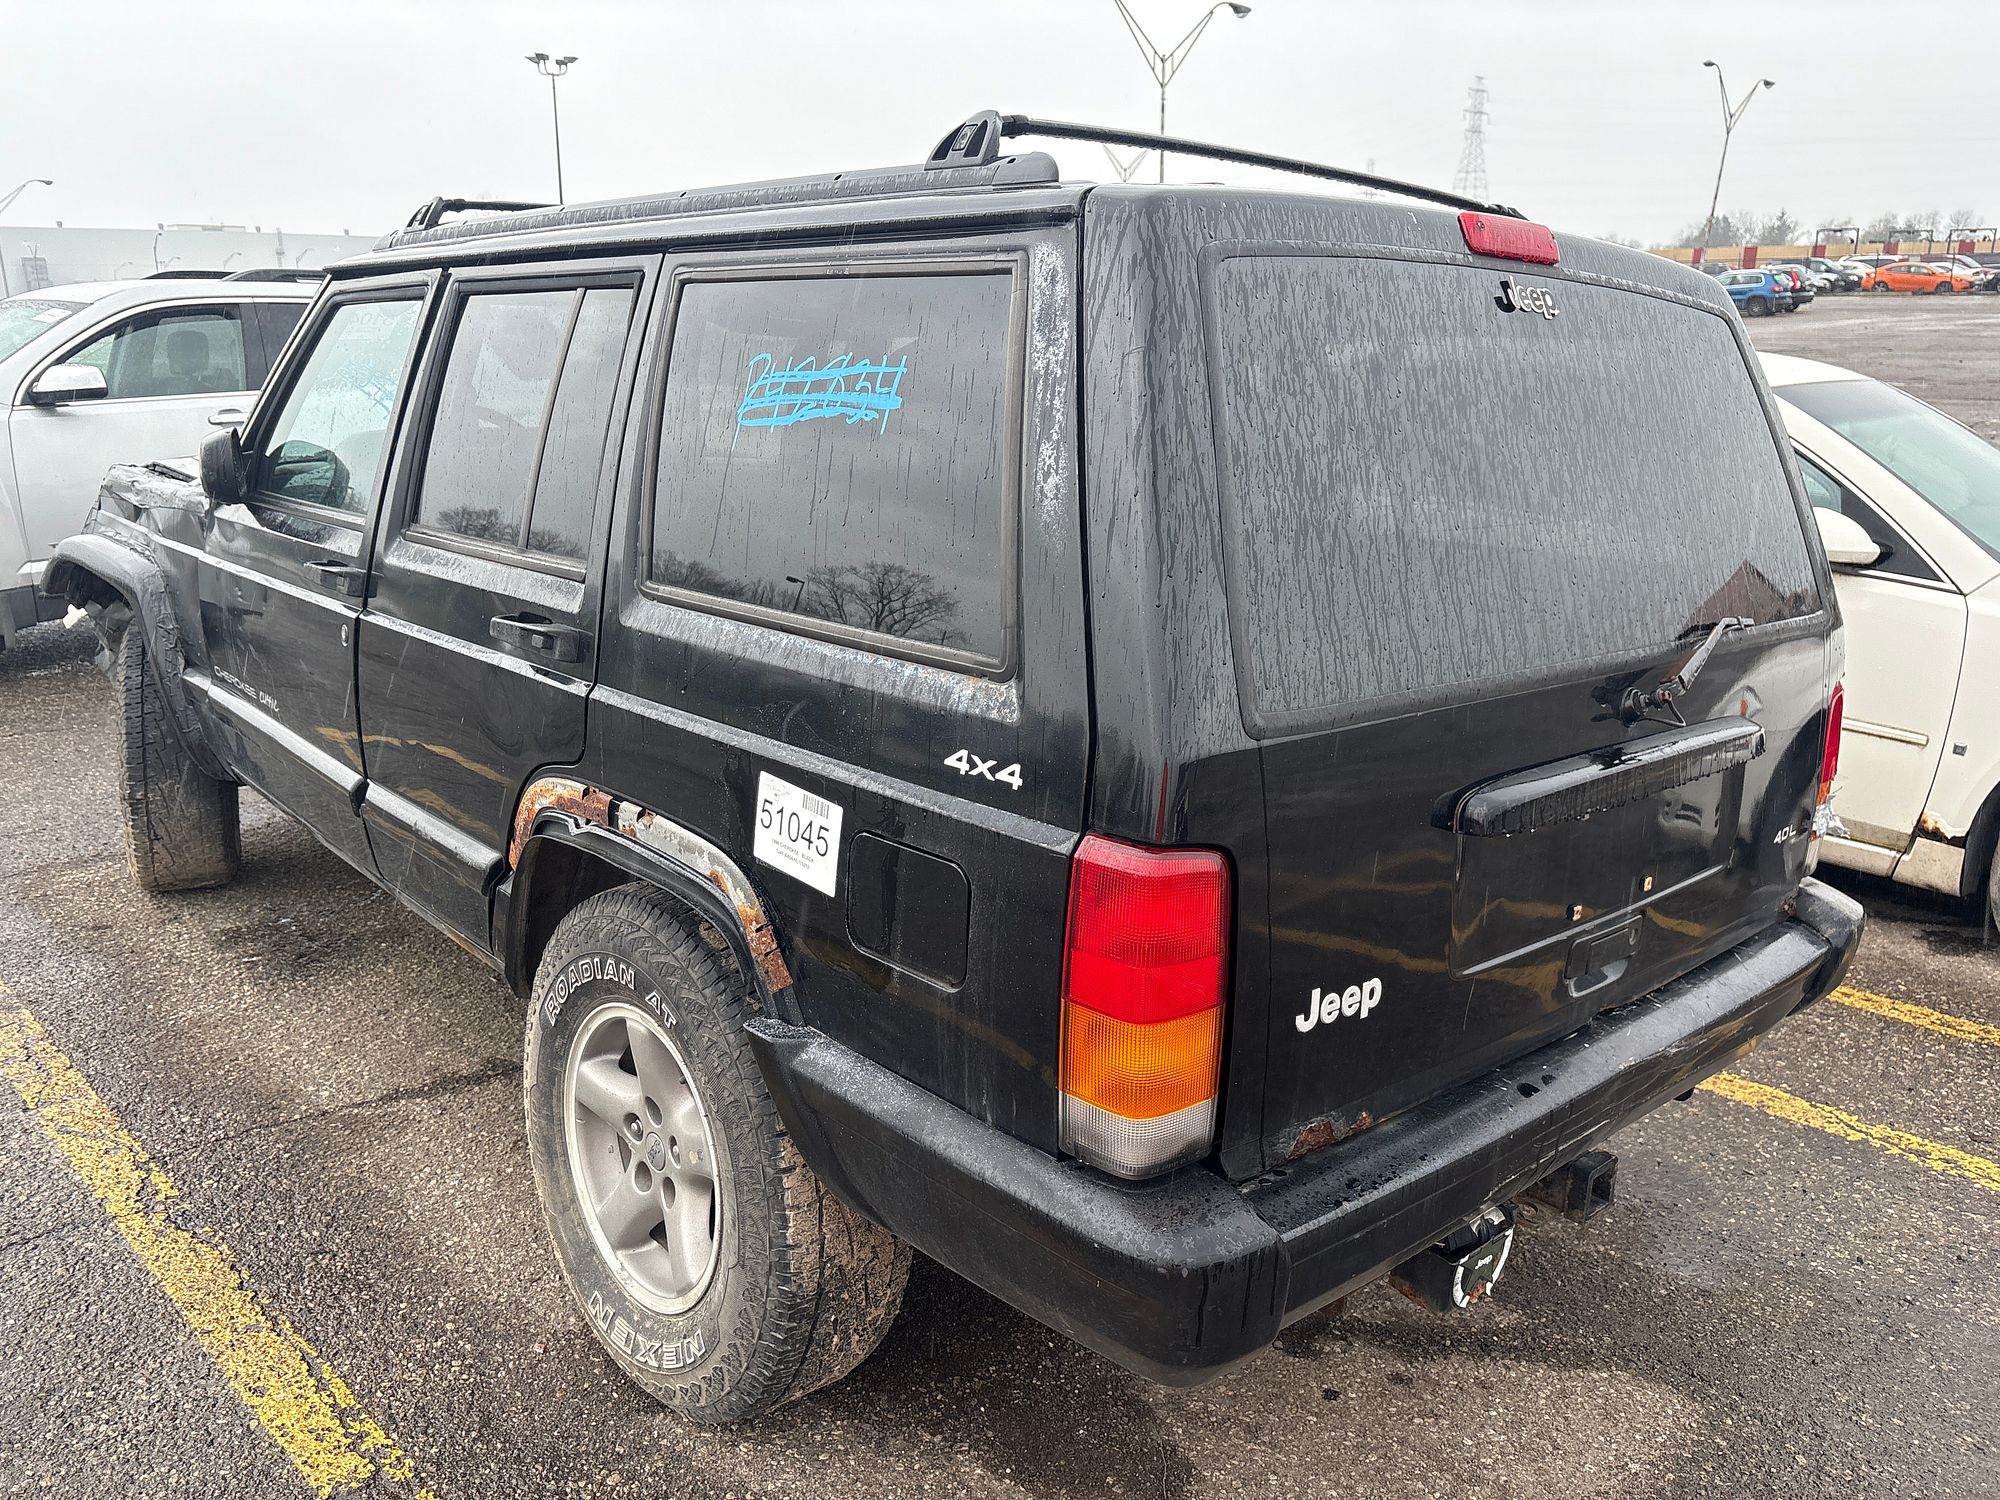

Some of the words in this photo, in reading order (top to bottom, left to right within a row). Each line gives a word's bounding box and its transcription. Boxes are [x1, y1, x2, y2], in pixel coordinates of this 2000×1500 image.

[1494, 275, 1560, 320] Jeep
[760, 798, 830, 857] 51045
[544, 957, 635, 1027] ROADIAN
[644, 990, 677, 1029] AT
[1295, 977, 1382, 1033] Jeep
[588, 1290, 706, 1369] NEXEN
